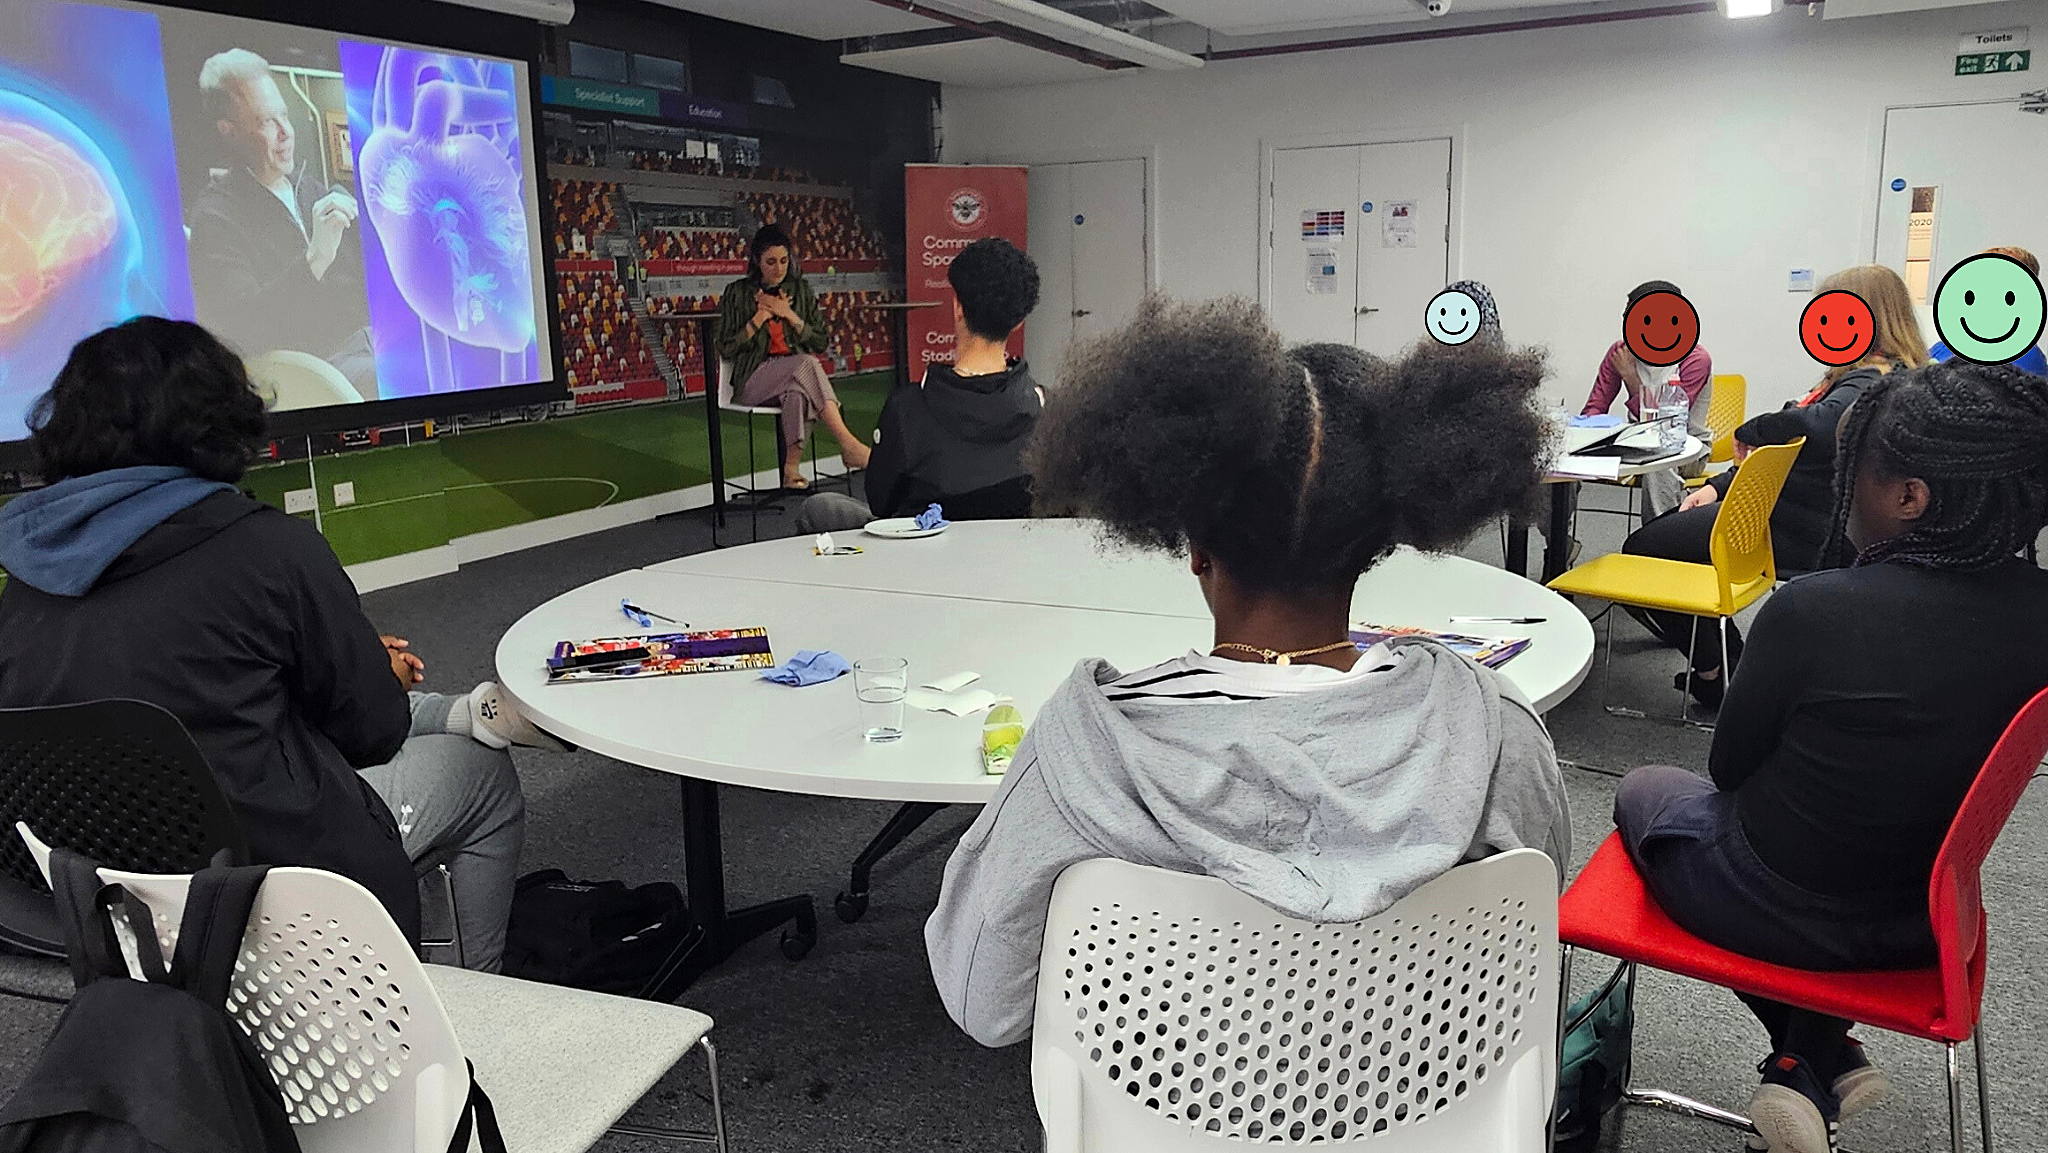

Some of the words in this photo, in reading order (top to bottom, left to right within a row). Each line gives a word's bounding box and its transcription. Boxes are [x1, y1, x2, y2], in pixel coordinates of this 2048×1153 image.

[1976, 34, 2013, 44] Toilets
[1959, 65, 1978, 73] exit
[575, 87, 613, 102] Specialist
[614, 93, 645, 107] Support
[923, 235, 977, 249] Comm
